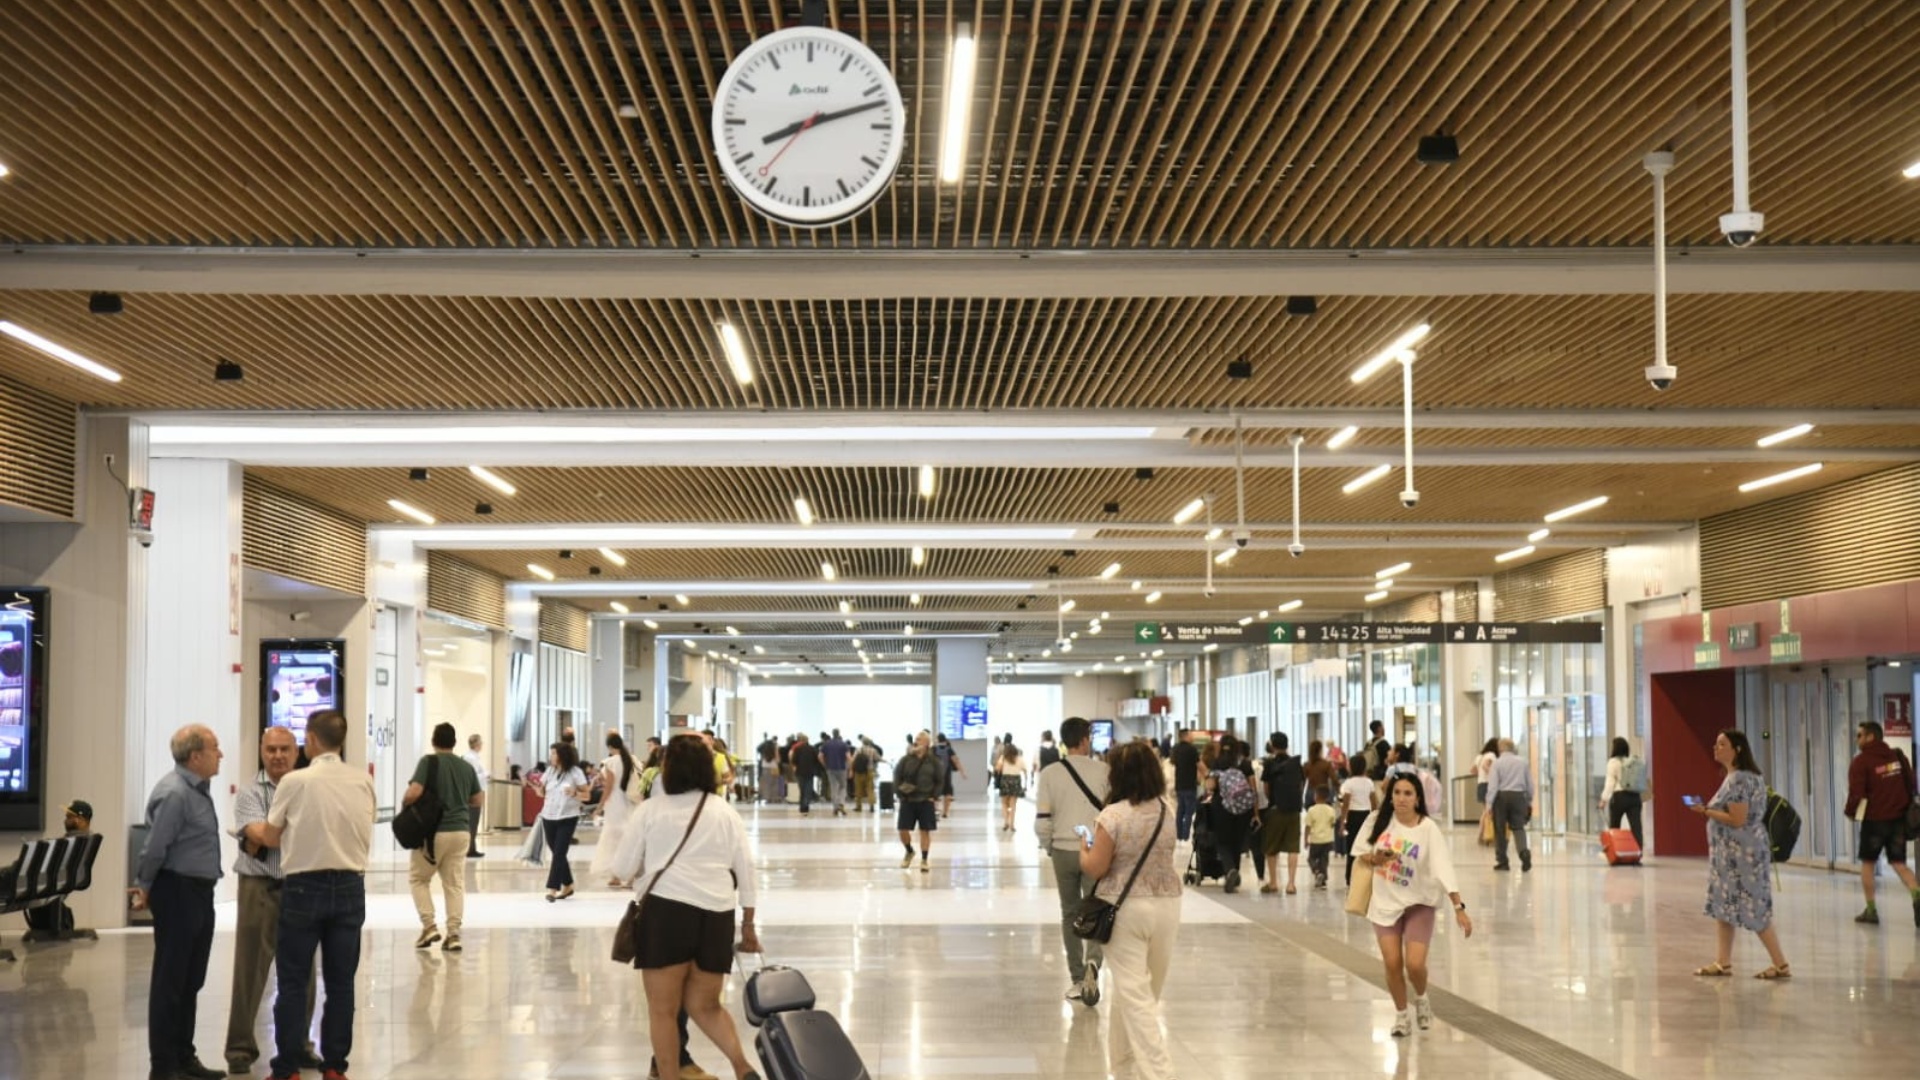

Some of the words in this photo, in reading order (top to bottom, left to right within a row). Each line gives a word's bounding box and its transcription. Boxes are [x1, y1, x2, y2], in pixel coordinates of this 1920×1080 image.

[1177, 625, 1200, 635] Venta
[1201, 625, 1212, 635] de
[1213, 625, 1243, 635] billetes
[1376, 625, 1392, 635] Alta
[1393, 625, 1431, 635] Velocidad
[1476, 624, 1487, 641] A
[1490, 625, 1518, 635] Acceso
